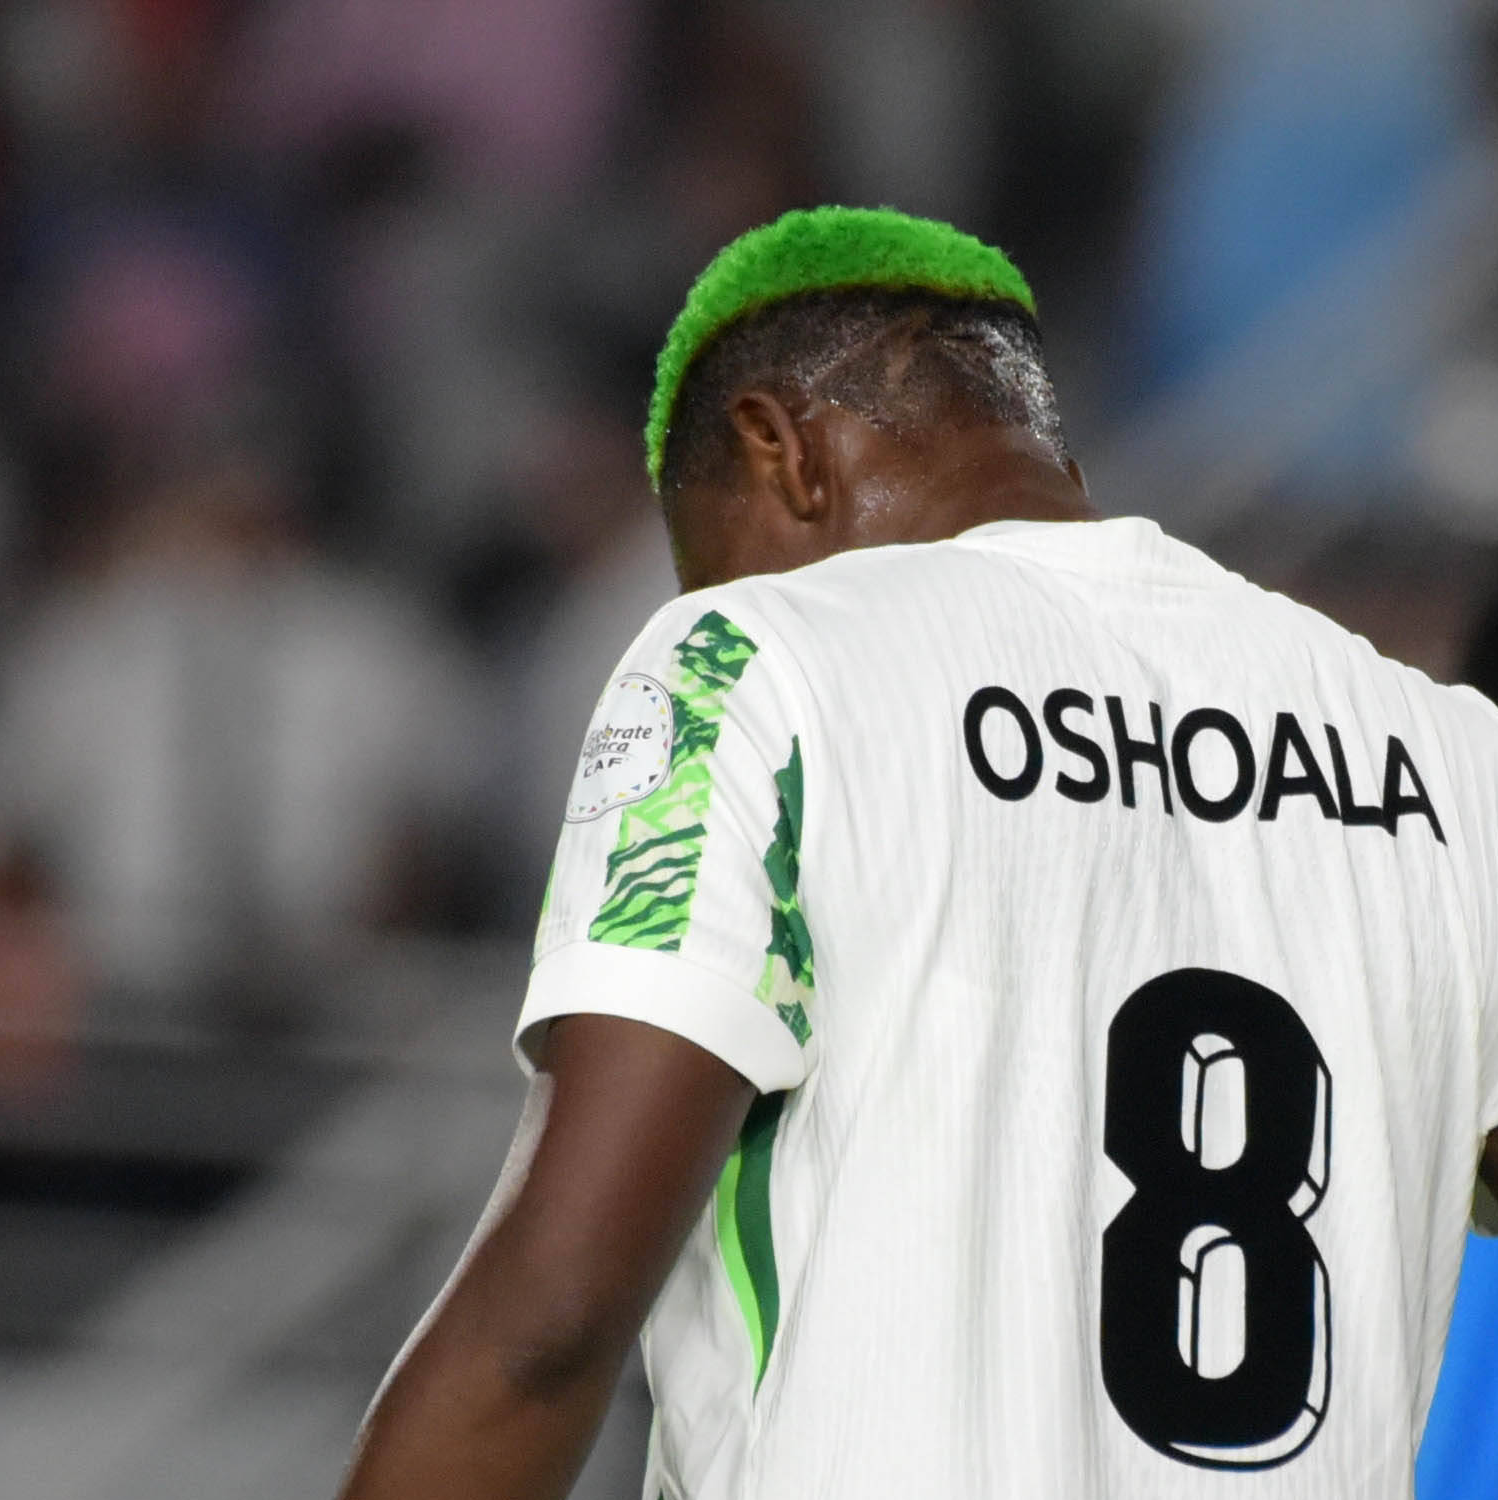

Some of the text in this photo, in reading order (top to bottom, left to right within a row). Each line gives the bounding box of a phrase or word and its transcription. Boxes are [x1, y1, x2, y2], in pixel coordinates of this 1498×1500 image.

[583, 757, 624, 778] CAF
[963, 686, 1447, 846] OSHOALA
[1100, 967, 1332, 1472] 8
